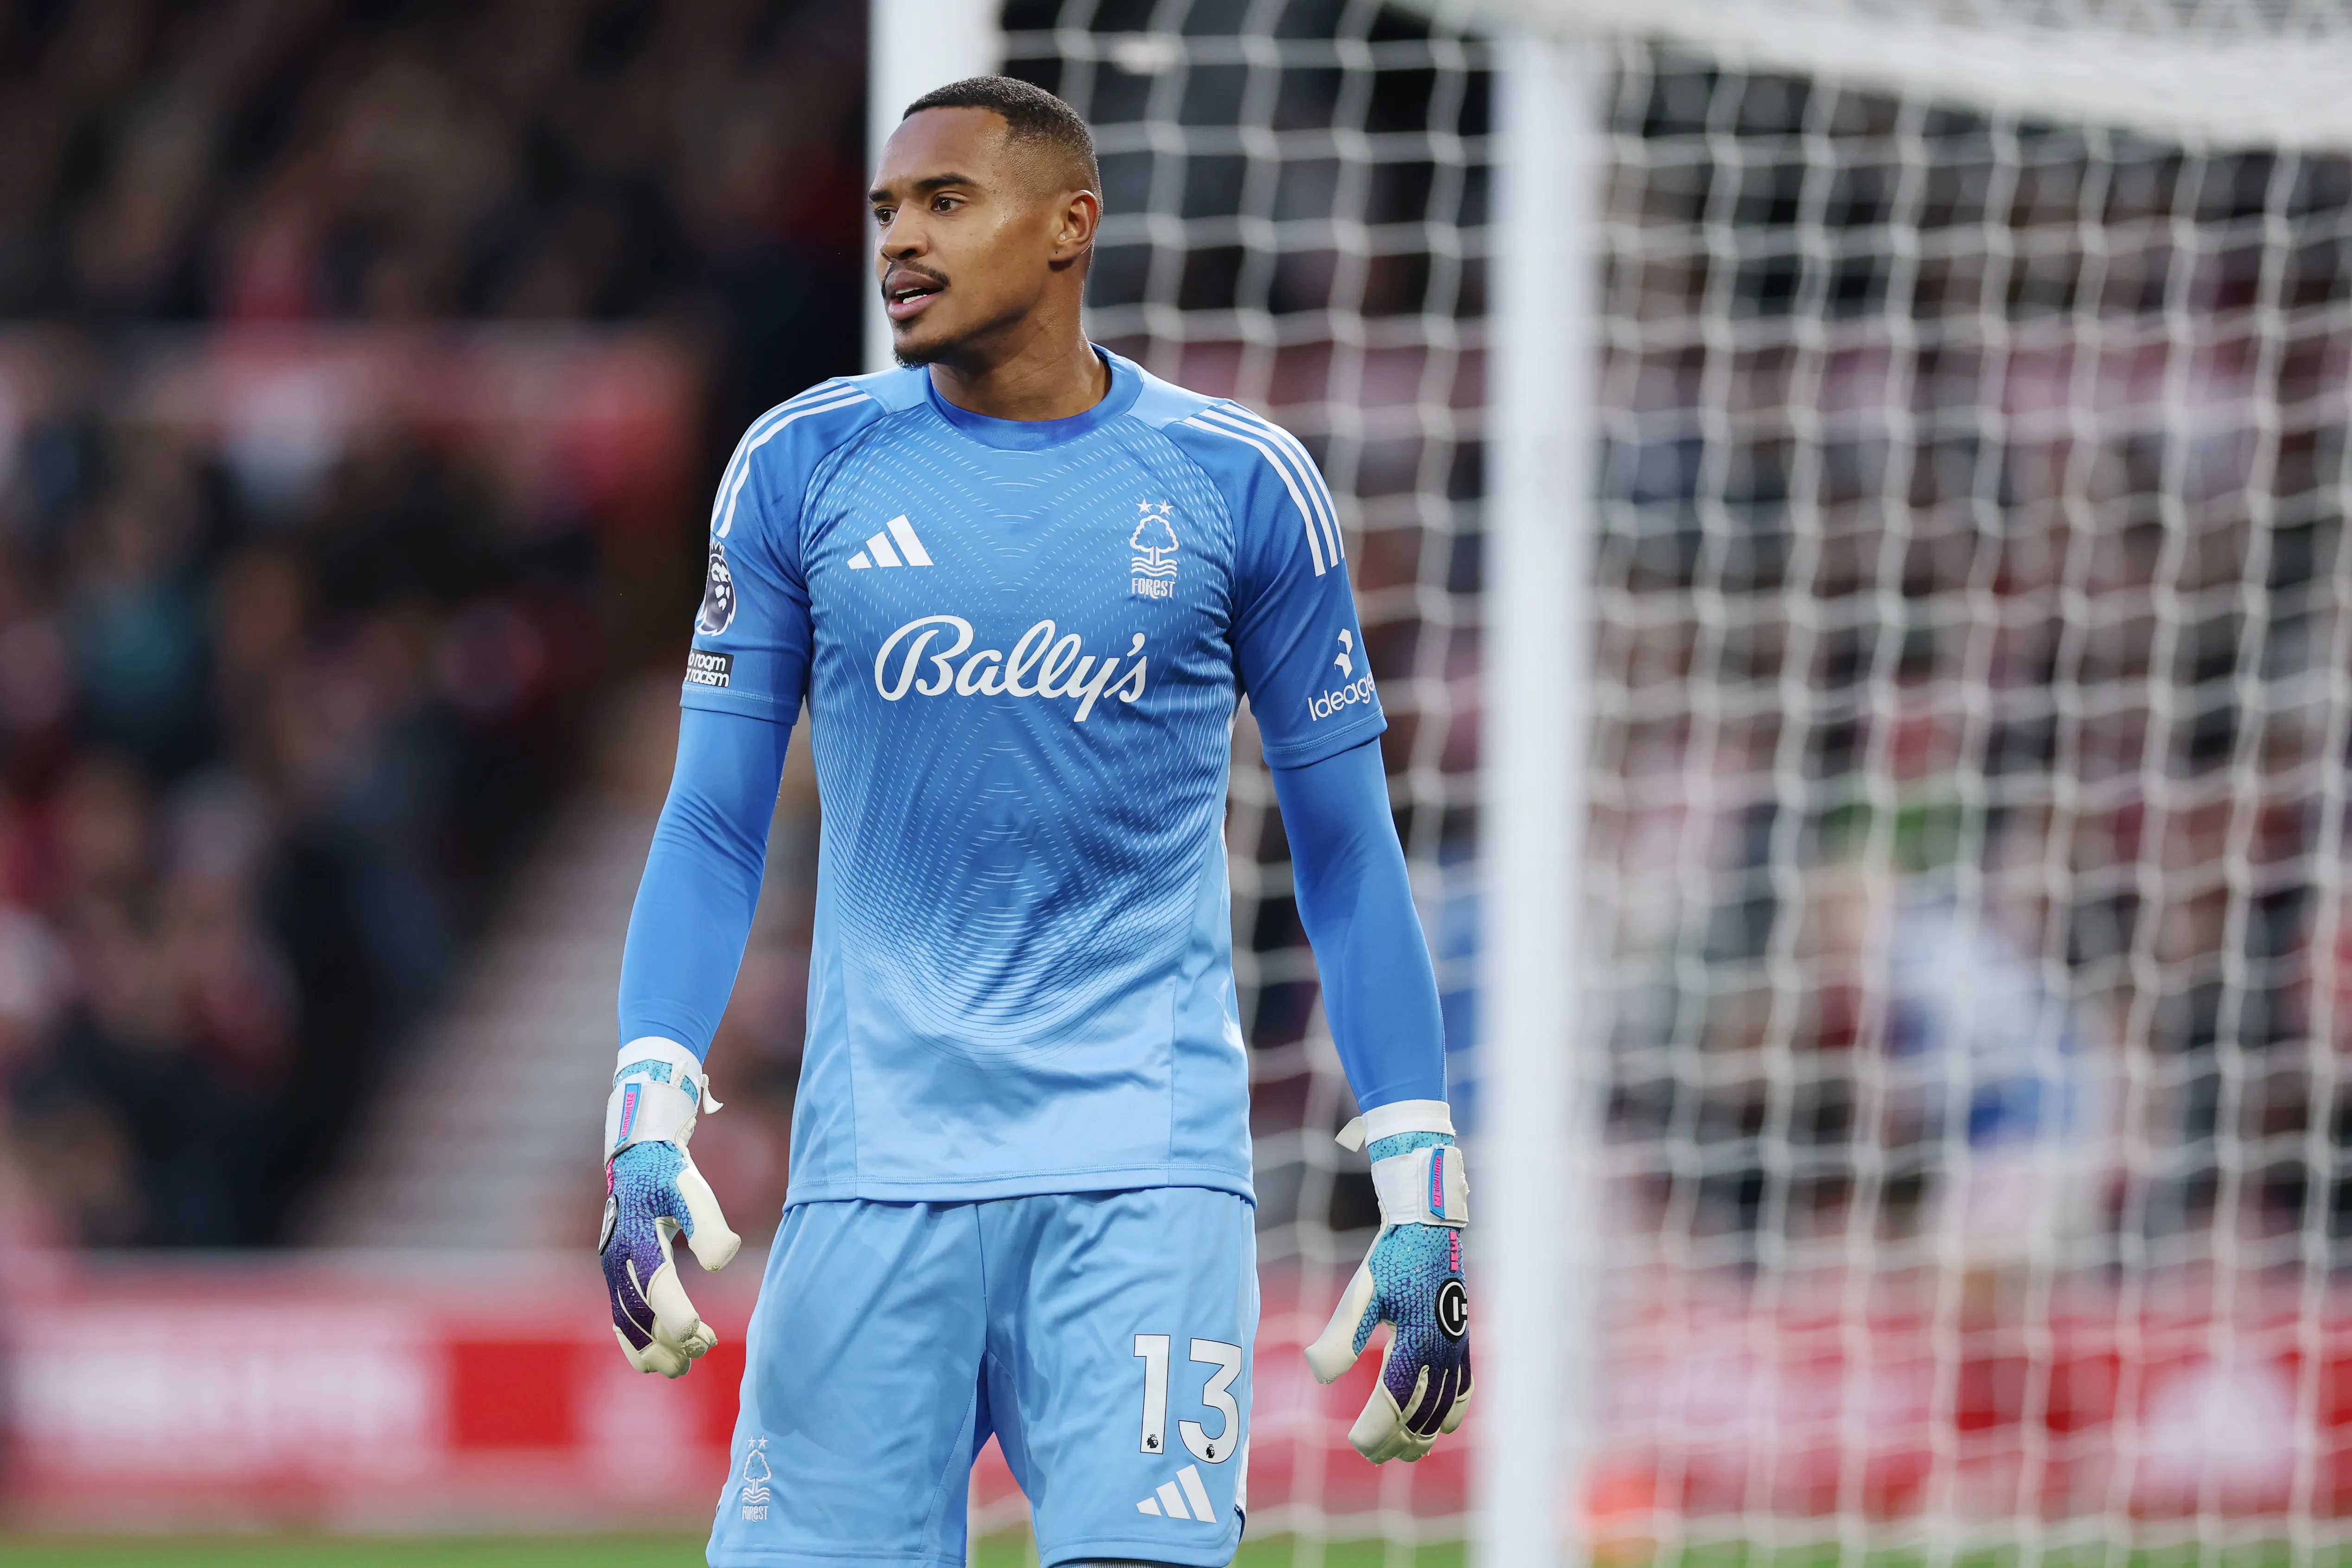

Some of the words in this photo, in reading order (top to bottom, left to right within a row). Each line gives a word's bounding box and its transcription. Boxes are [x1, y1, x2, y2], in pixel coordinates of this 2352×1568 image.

[689, 668, 729, 687] racism
[694, 654, 726, 671] room
[874, 615, 1147, 722] Bally's
[1308, 672, 1376, 722] Ideage
[1134, 1334, 1242, 1464] 13
